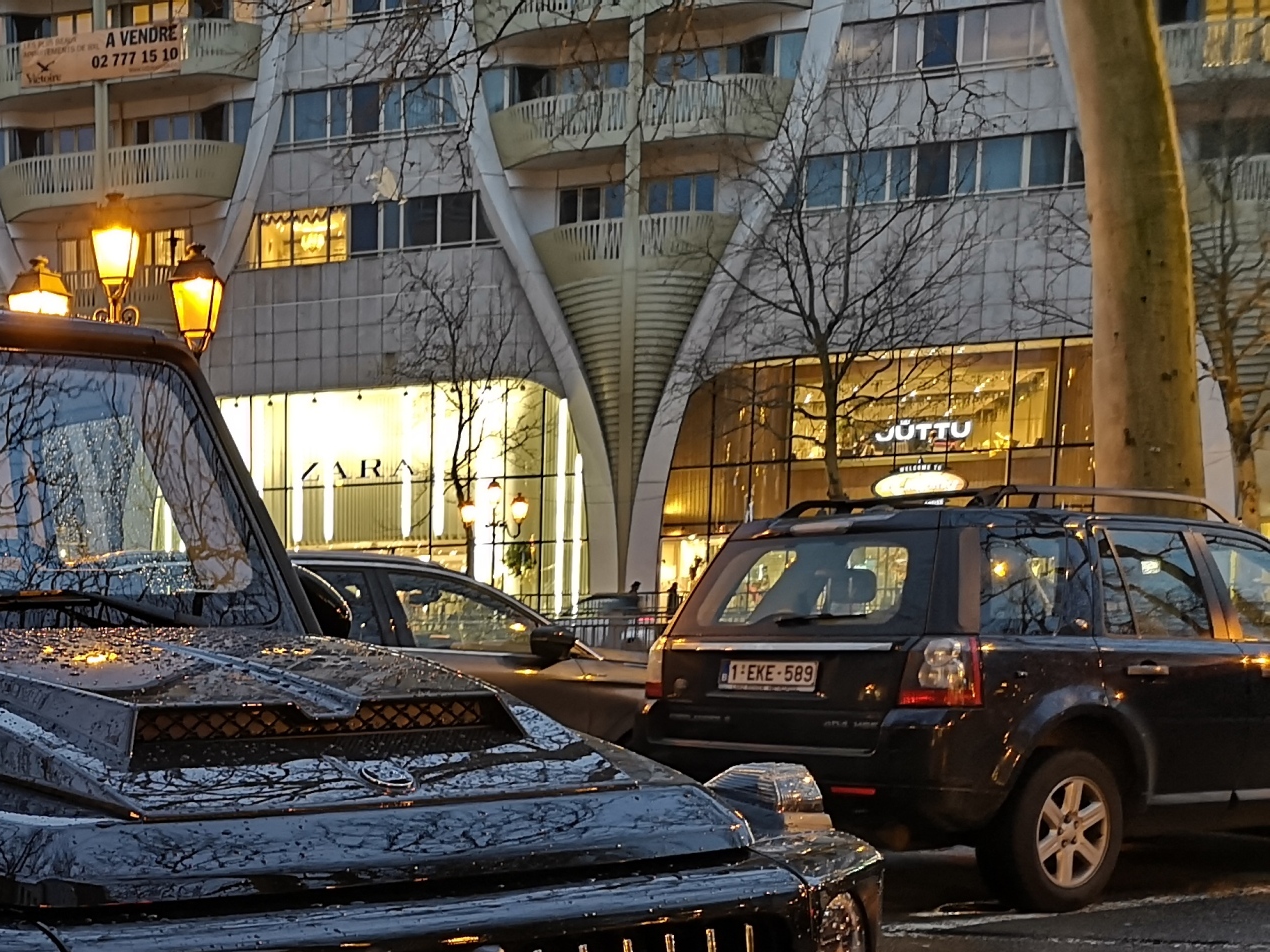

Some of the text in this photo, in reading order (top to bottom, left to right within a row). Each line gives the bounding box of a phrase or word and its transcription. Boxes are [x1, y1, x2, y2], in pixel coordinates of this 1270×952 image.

[105, 24, 178, 48] A VENDRE
[91, 47, 179, 69] 02 777 15 10
[301, 458, 415, 482] ZARA
[899, 464, 932, 473] WELCOME
[731, 663, 814, 682] 1-EKE-589
